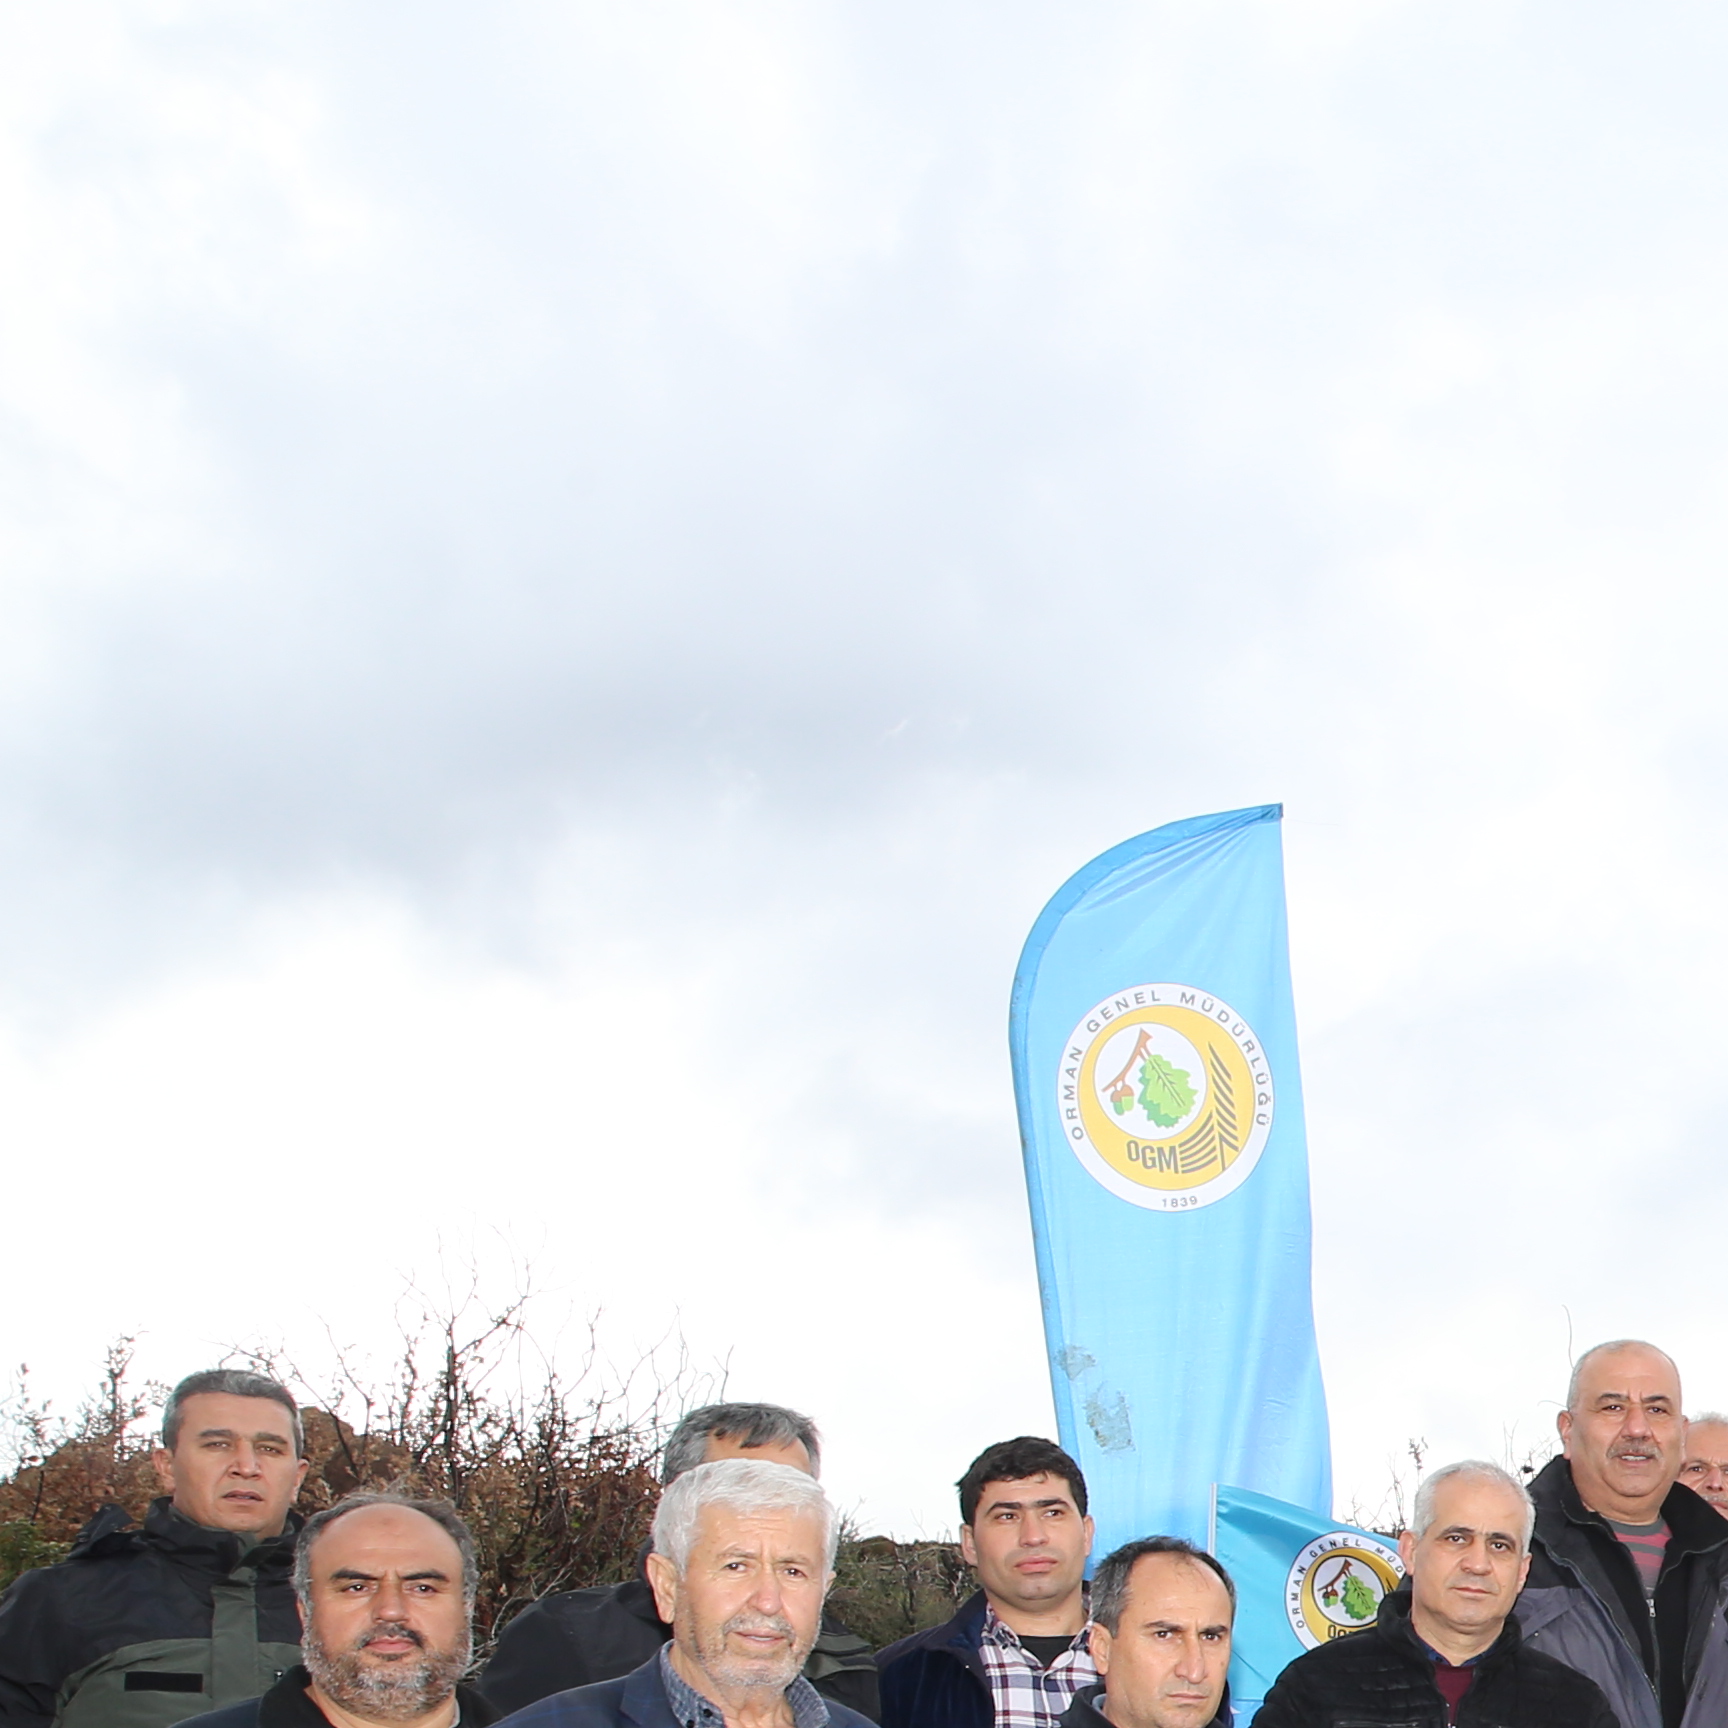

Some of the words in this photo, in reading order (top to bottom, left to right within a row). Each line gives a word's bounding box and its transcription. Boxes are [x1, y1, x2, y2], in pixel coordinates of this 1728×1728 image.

[1063, 1046, 1084, 1141] ORMAN
[1086, 990, 1161, 1033] GENEL
[1180, 991, 1271, 1126] MÜDÜRLÜĞÜ
[1126, 1140, 1180, 1174] OGM
[1162, 1196, 1198, 1208] 1839
[1291, 1565, 1307, 1628] ORMAN
[1309, 1537, 1361, 1558] GENEL
